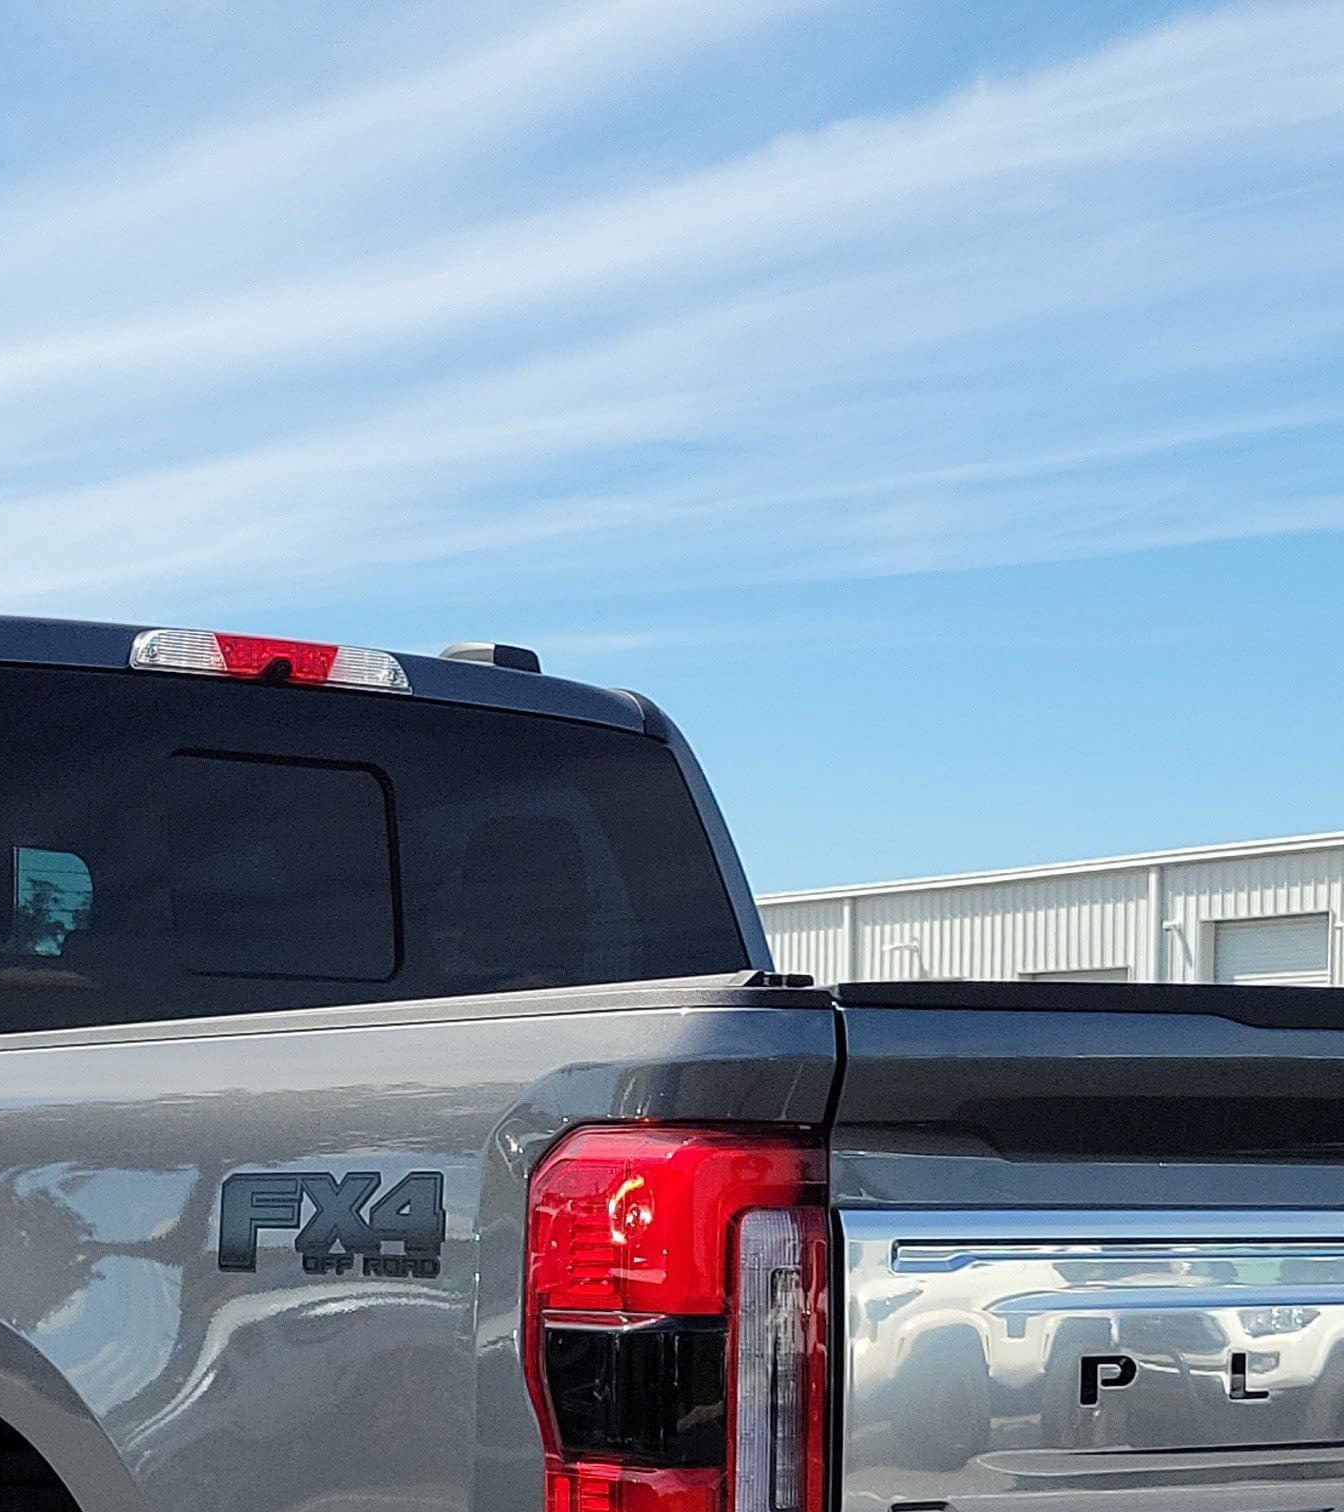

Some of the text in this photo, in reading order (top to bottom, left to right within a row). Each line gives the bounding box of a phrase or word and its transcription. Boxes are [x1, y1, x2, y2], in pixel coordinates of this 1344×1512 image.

[218, 1171, 446, 1273] FX4
[302, 1253, 441, 1279] OFF ROAD
